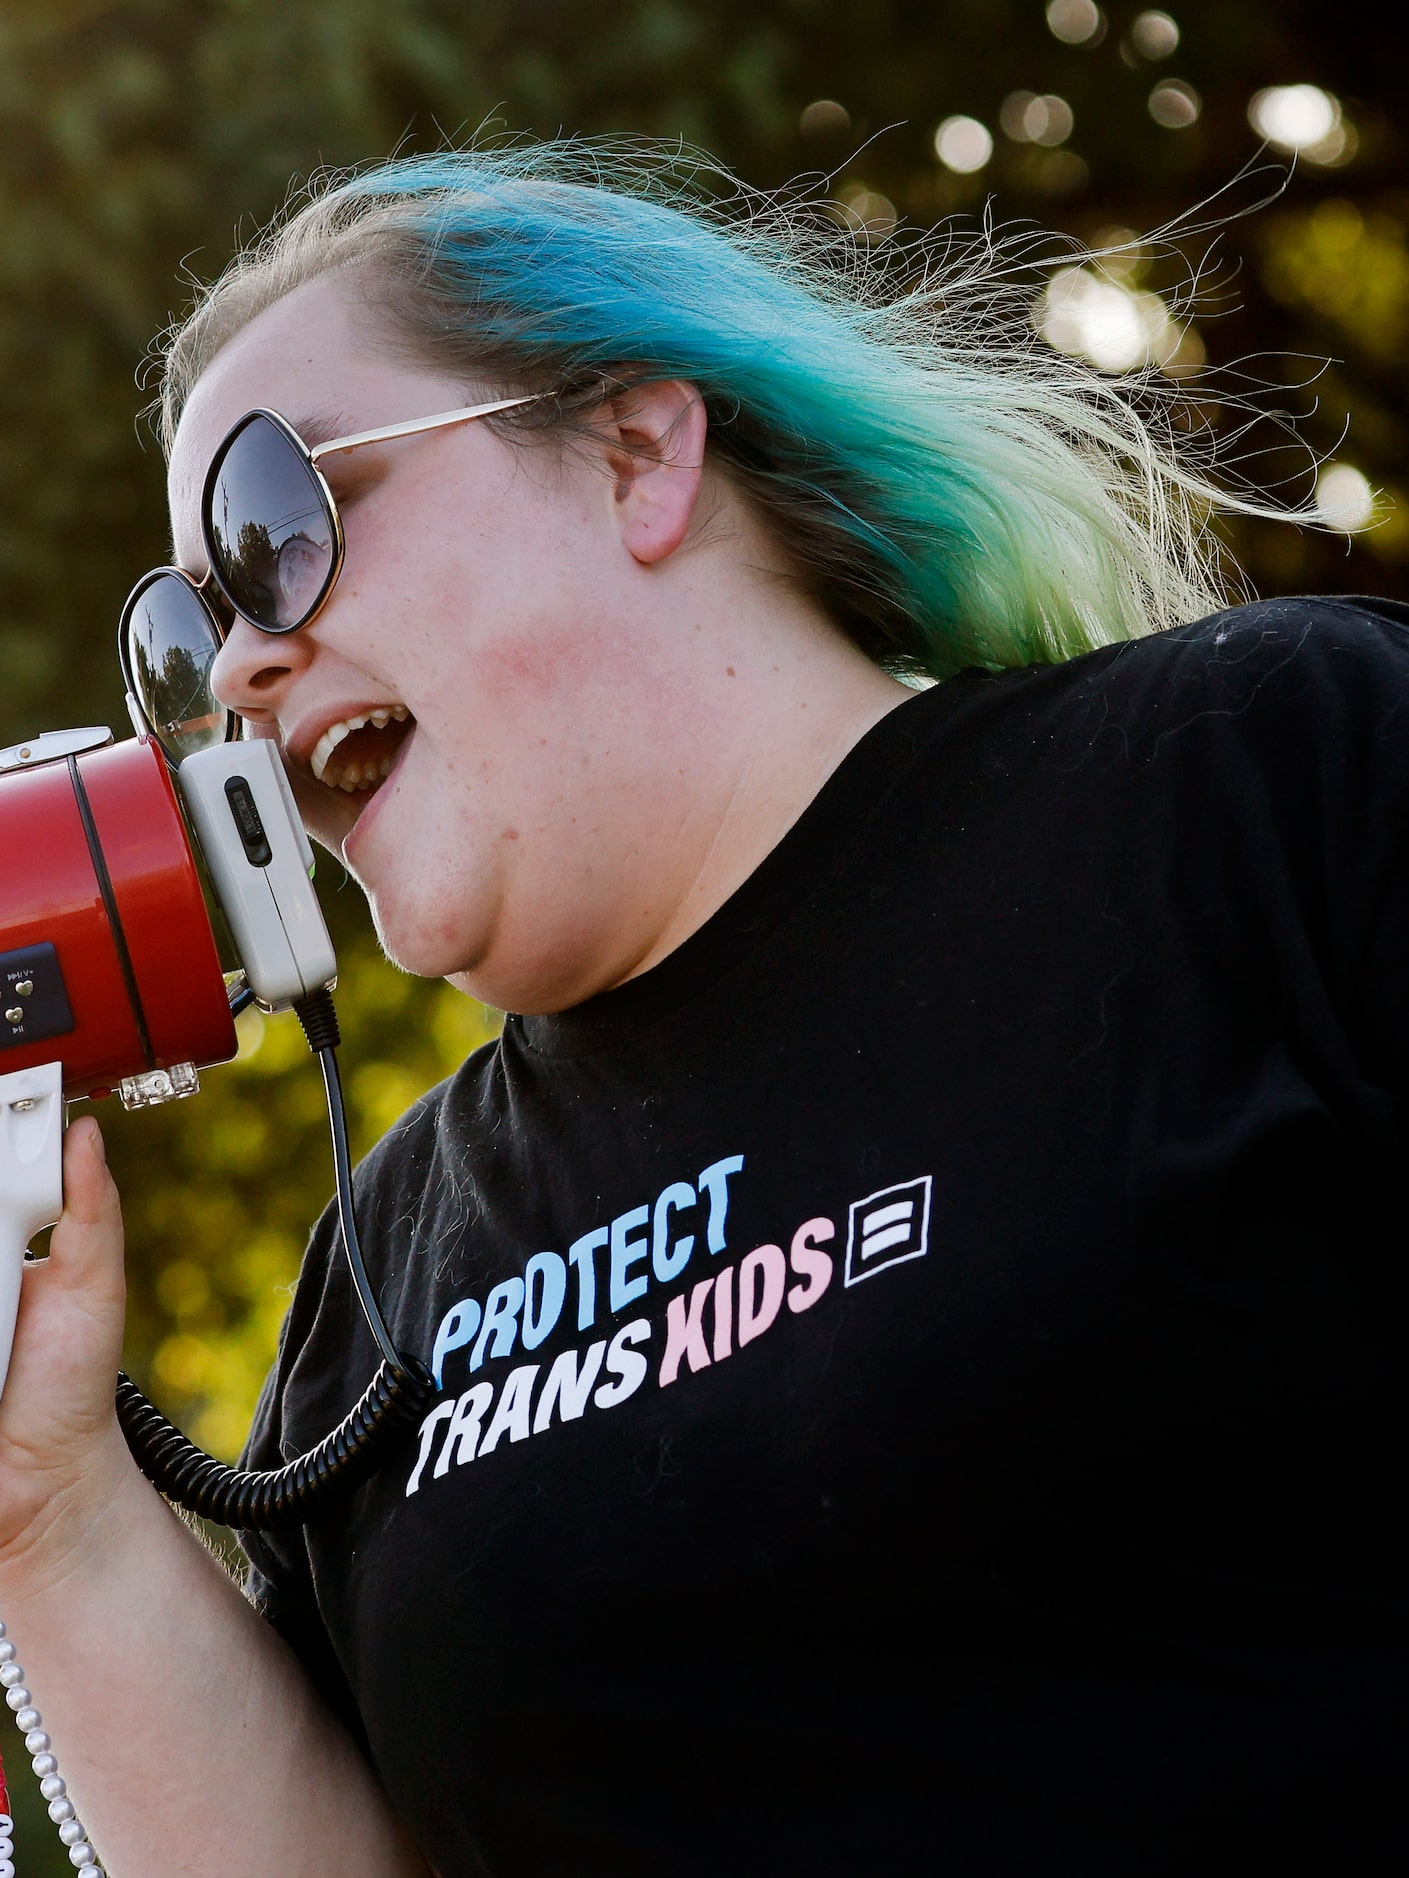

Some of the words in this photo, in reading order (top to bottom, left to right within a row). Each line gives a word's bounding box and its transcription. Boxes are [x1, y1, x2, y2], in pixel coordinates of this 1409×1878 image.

[405, 1318, 651, 1498] TRANS
[659, 1216, 835, 1389] KIDS
[432, 1154, 744, 1392] PROTECT
